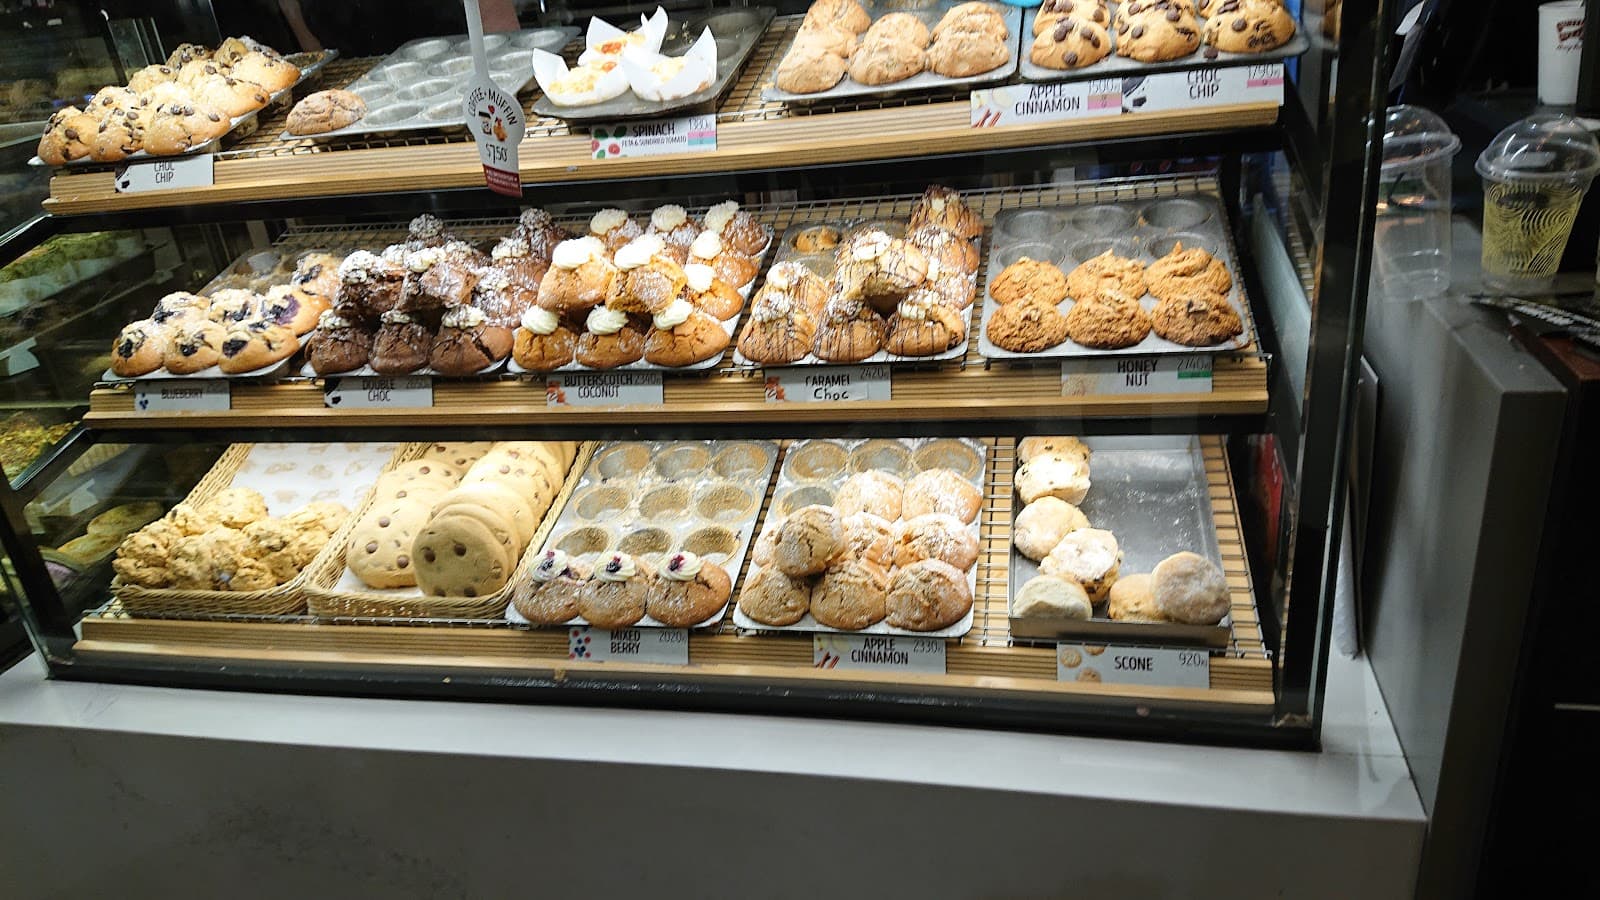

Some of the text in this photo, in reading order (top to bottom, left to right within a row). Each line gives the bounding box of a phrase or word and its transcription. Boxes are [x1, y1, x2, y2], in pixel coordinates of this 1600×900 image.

[1188, 68, 1221, 84] CHOC
[1029, 84, 1064, 100] APPLE
[1189, 83, 1219, 100] CHIP
[468, 87, 518, 125] COFFEE MUFFIN
[1015, 96, 1080, 116] CINNAMON
[632, 122, 675, 137] SPINACH
[155, 172, 174, 184] CHIP
[1117, 359, 1158, 373] HONEY
[362, 379, 395, 391] DOUBLE
[564, 373, 633, 387] BUTTERSCOTCH
[1126, 373, 1150, 387] NUT
[161, 387, 203, 399] BLUEBERRY
[368, 390, 391, 402] CHOC
[578, 384, 620, 399] COCONUT
[813, 387, 849, 401] Choc
[610, 628, 640, 642] MIXED
[610, 641, 641, 654] BERRY
[863, 637, 896, 651] APPLE
[851, 649, 908, 665] CINNAMON
[1114, 655, 1153, 671] SCONE
